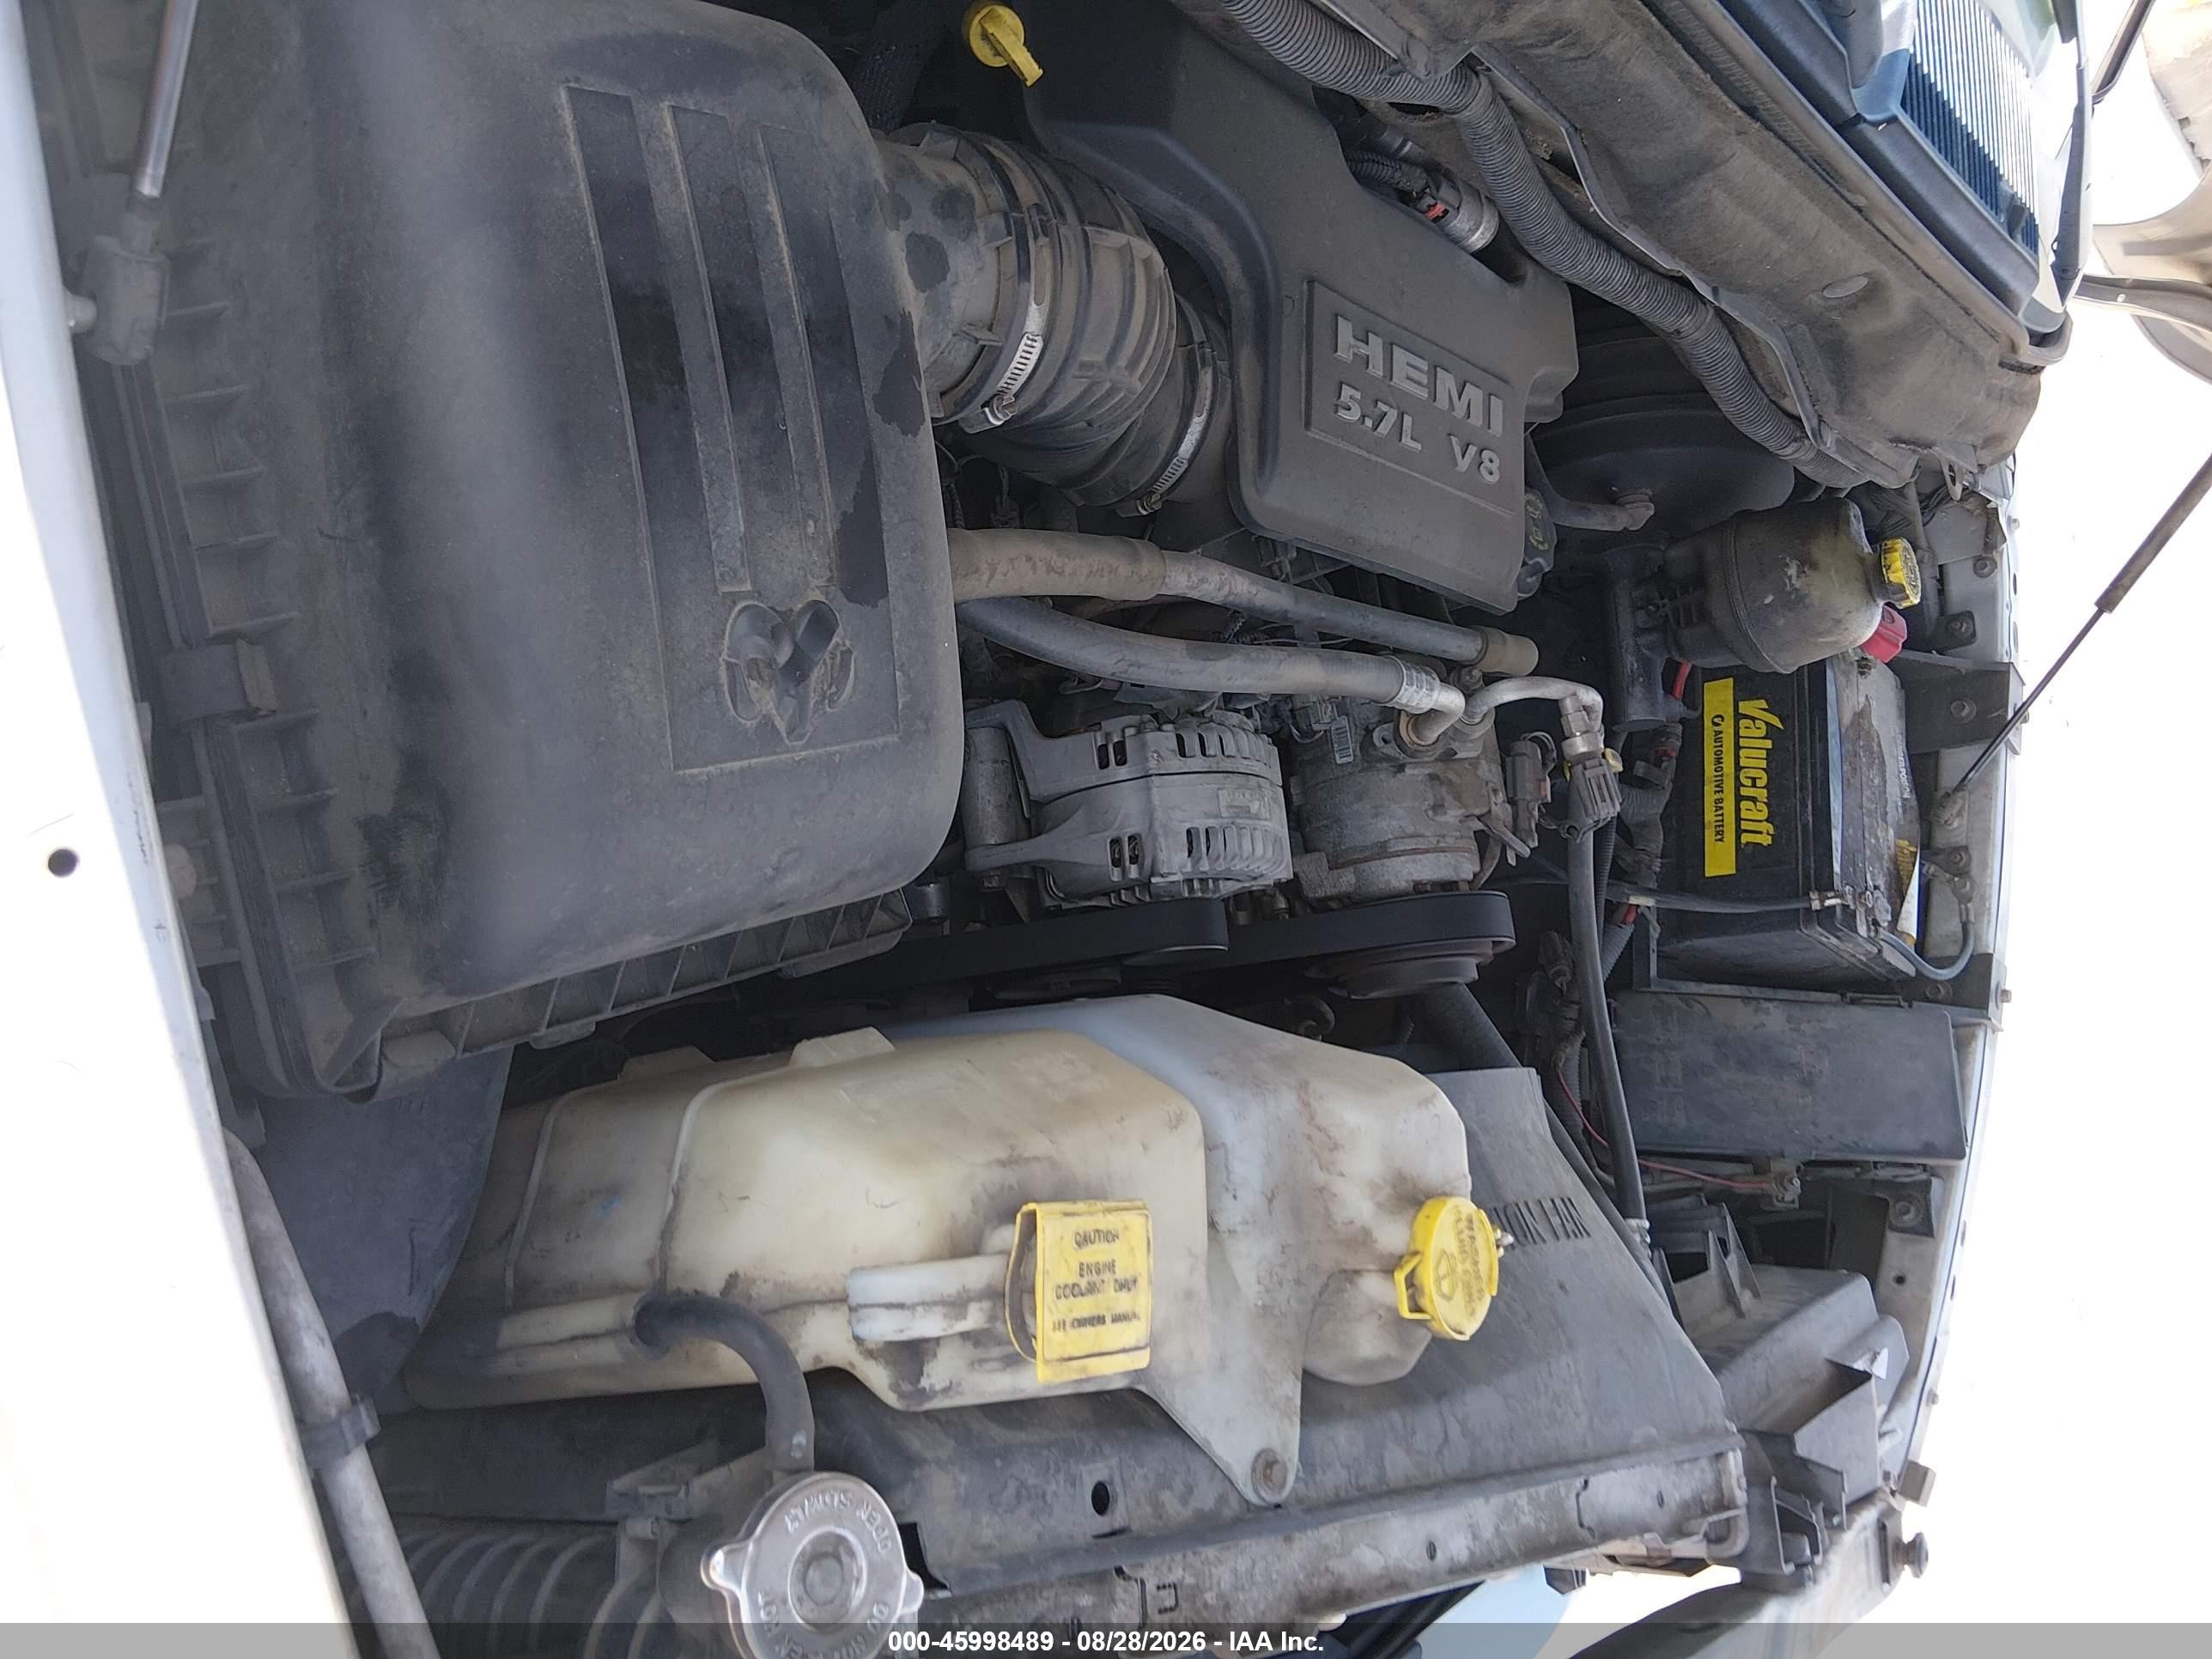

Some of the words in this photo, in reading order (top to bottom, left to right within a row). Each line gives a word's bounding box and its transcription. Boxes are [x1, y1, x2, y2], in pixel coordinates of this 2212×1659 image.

[1334, 315, 1503, 438] HEMI
[1334, 383, 1422, 453] 5.7L
[1447, 434, 1500, 484] V8
[1711, 730, 1725, 795] AUTOMOTIVE
[1738, 699, 1784, 848] Valucraft
[1713, 796, 1726, 843] BATTERY
[1073, 1229, 1121, 1248] CAUTION
[1079, 1258, 1117, 1278] ENGINE
